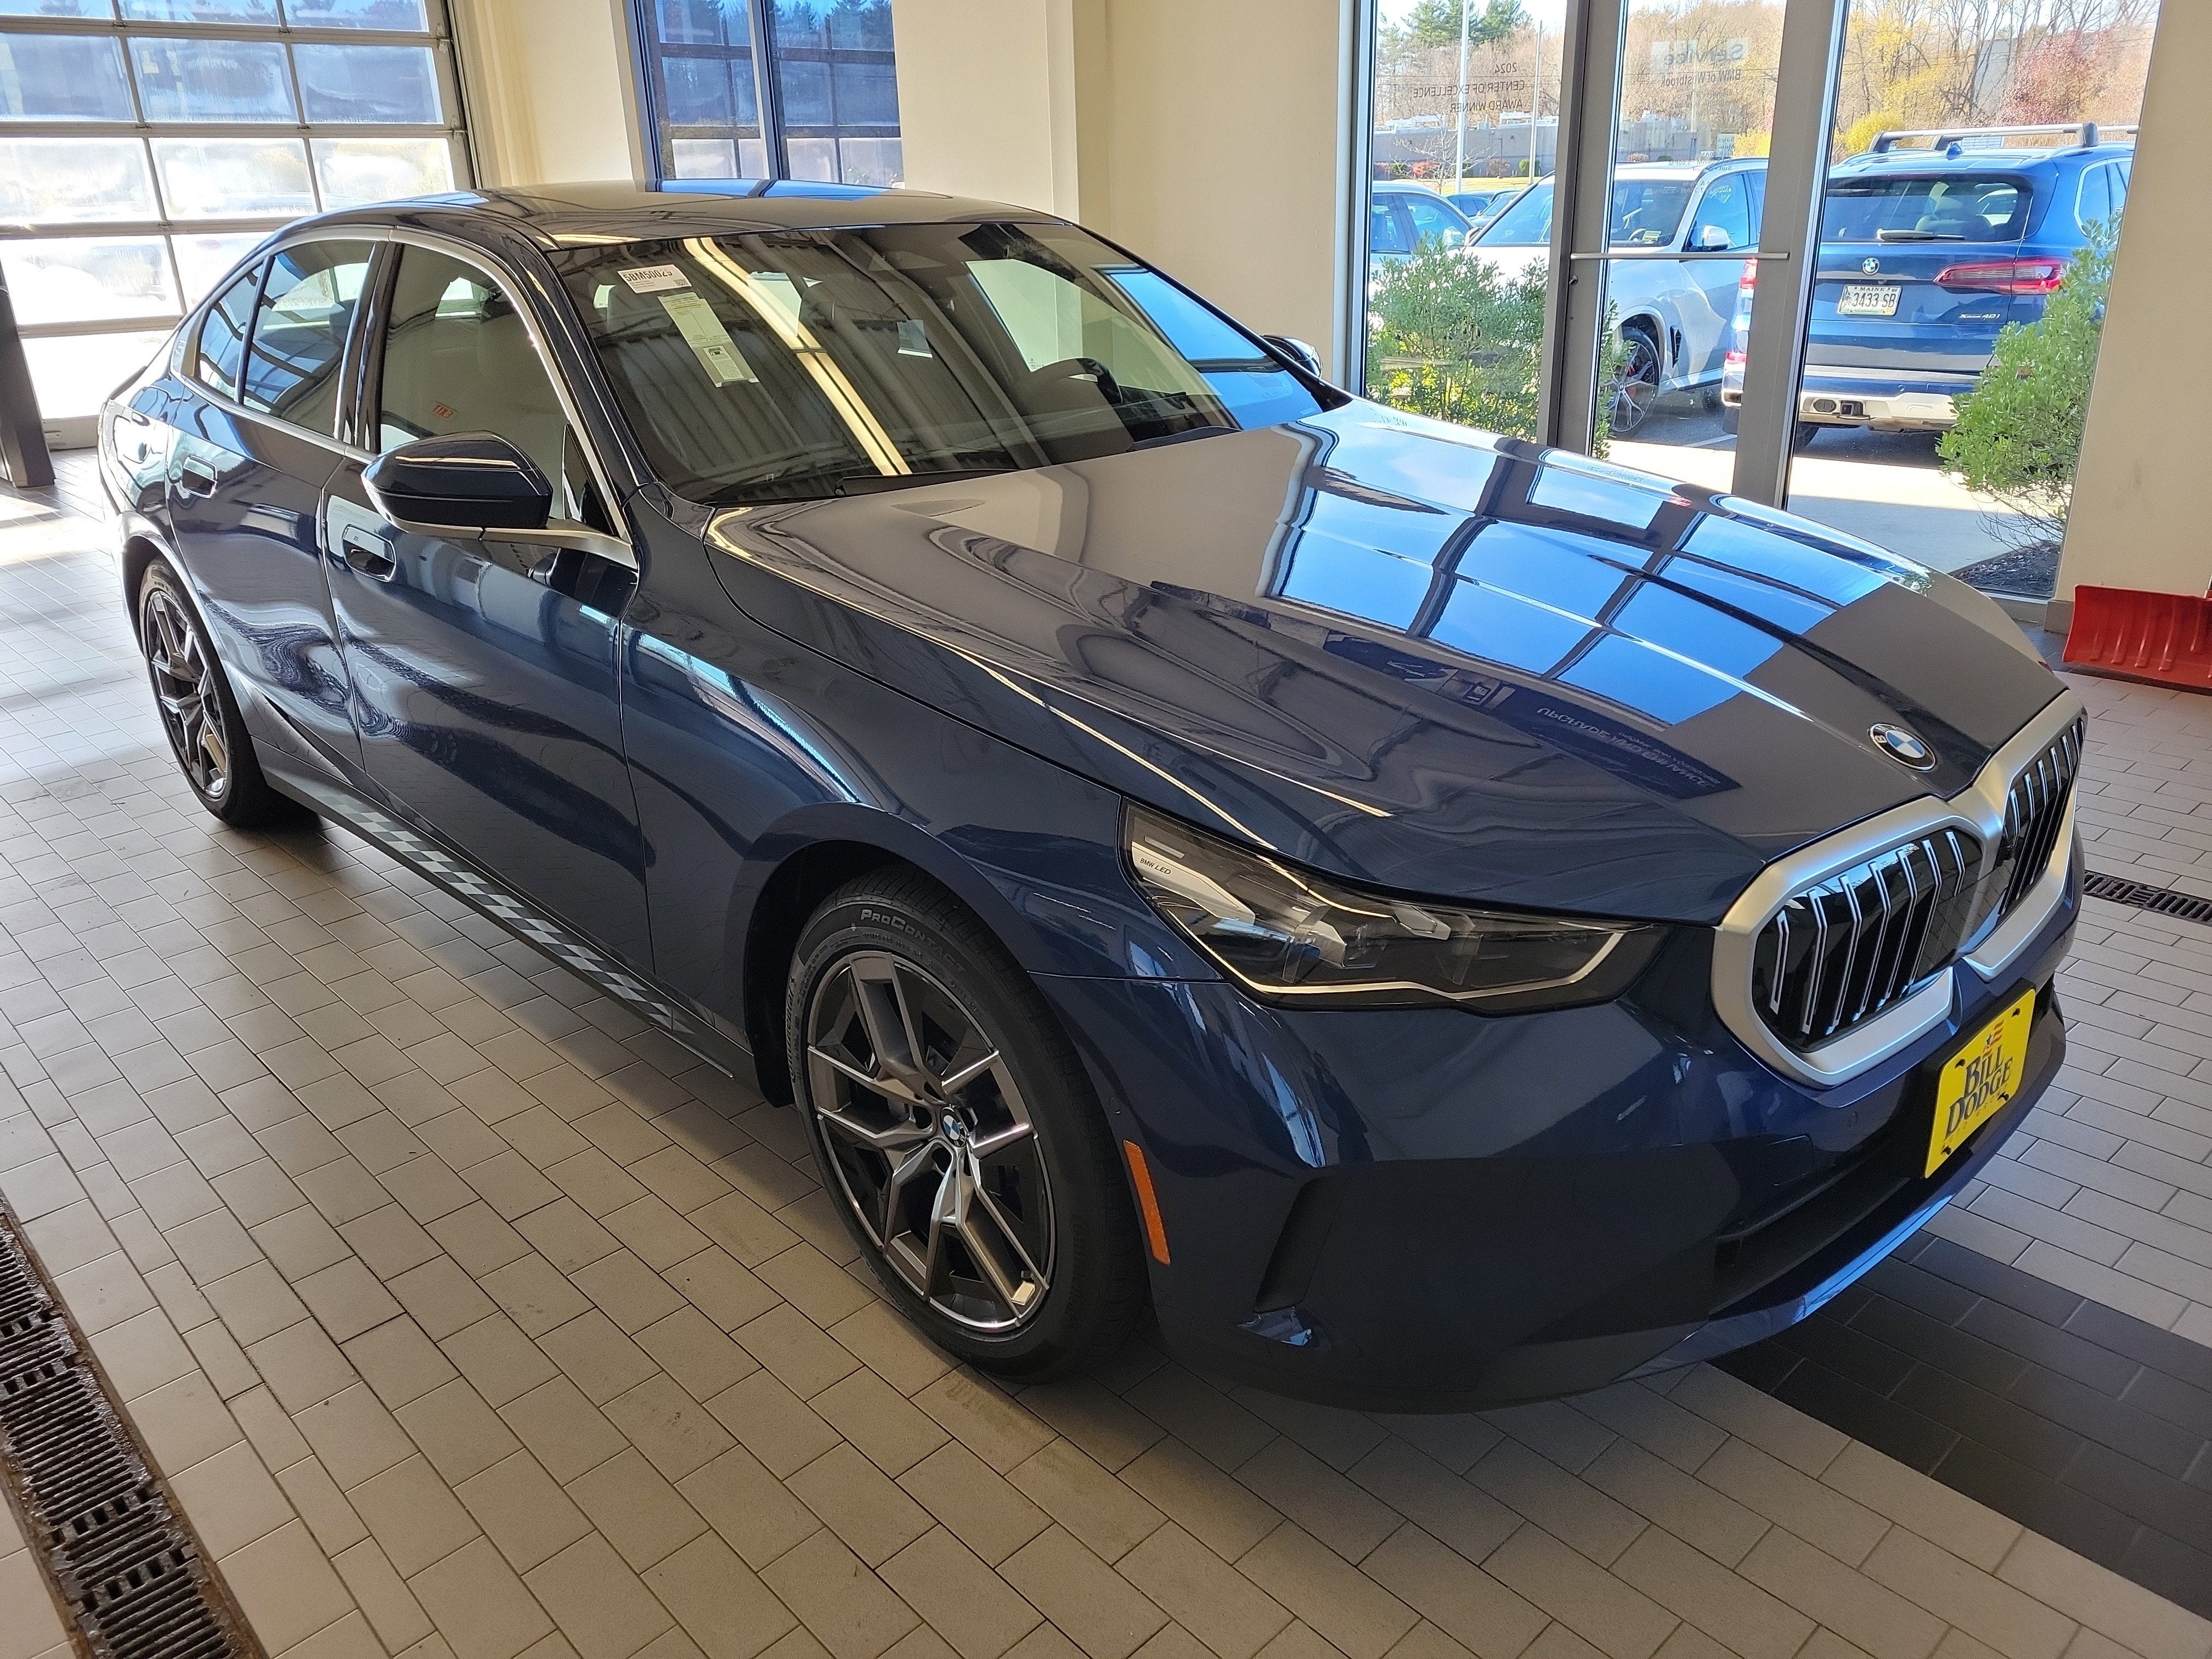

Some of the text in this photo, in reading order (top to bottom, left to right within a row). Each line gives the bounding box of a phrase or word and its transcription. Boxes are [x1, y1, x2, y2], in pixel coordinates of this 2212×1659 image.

[1852, 292, 1896, 307] 3433 SB
[1140, 858, 1171, 874] BMW LED
[1963, 1045, 2003, 1098] BILL
[1944, 1057, 2013, 1141] DODGE
